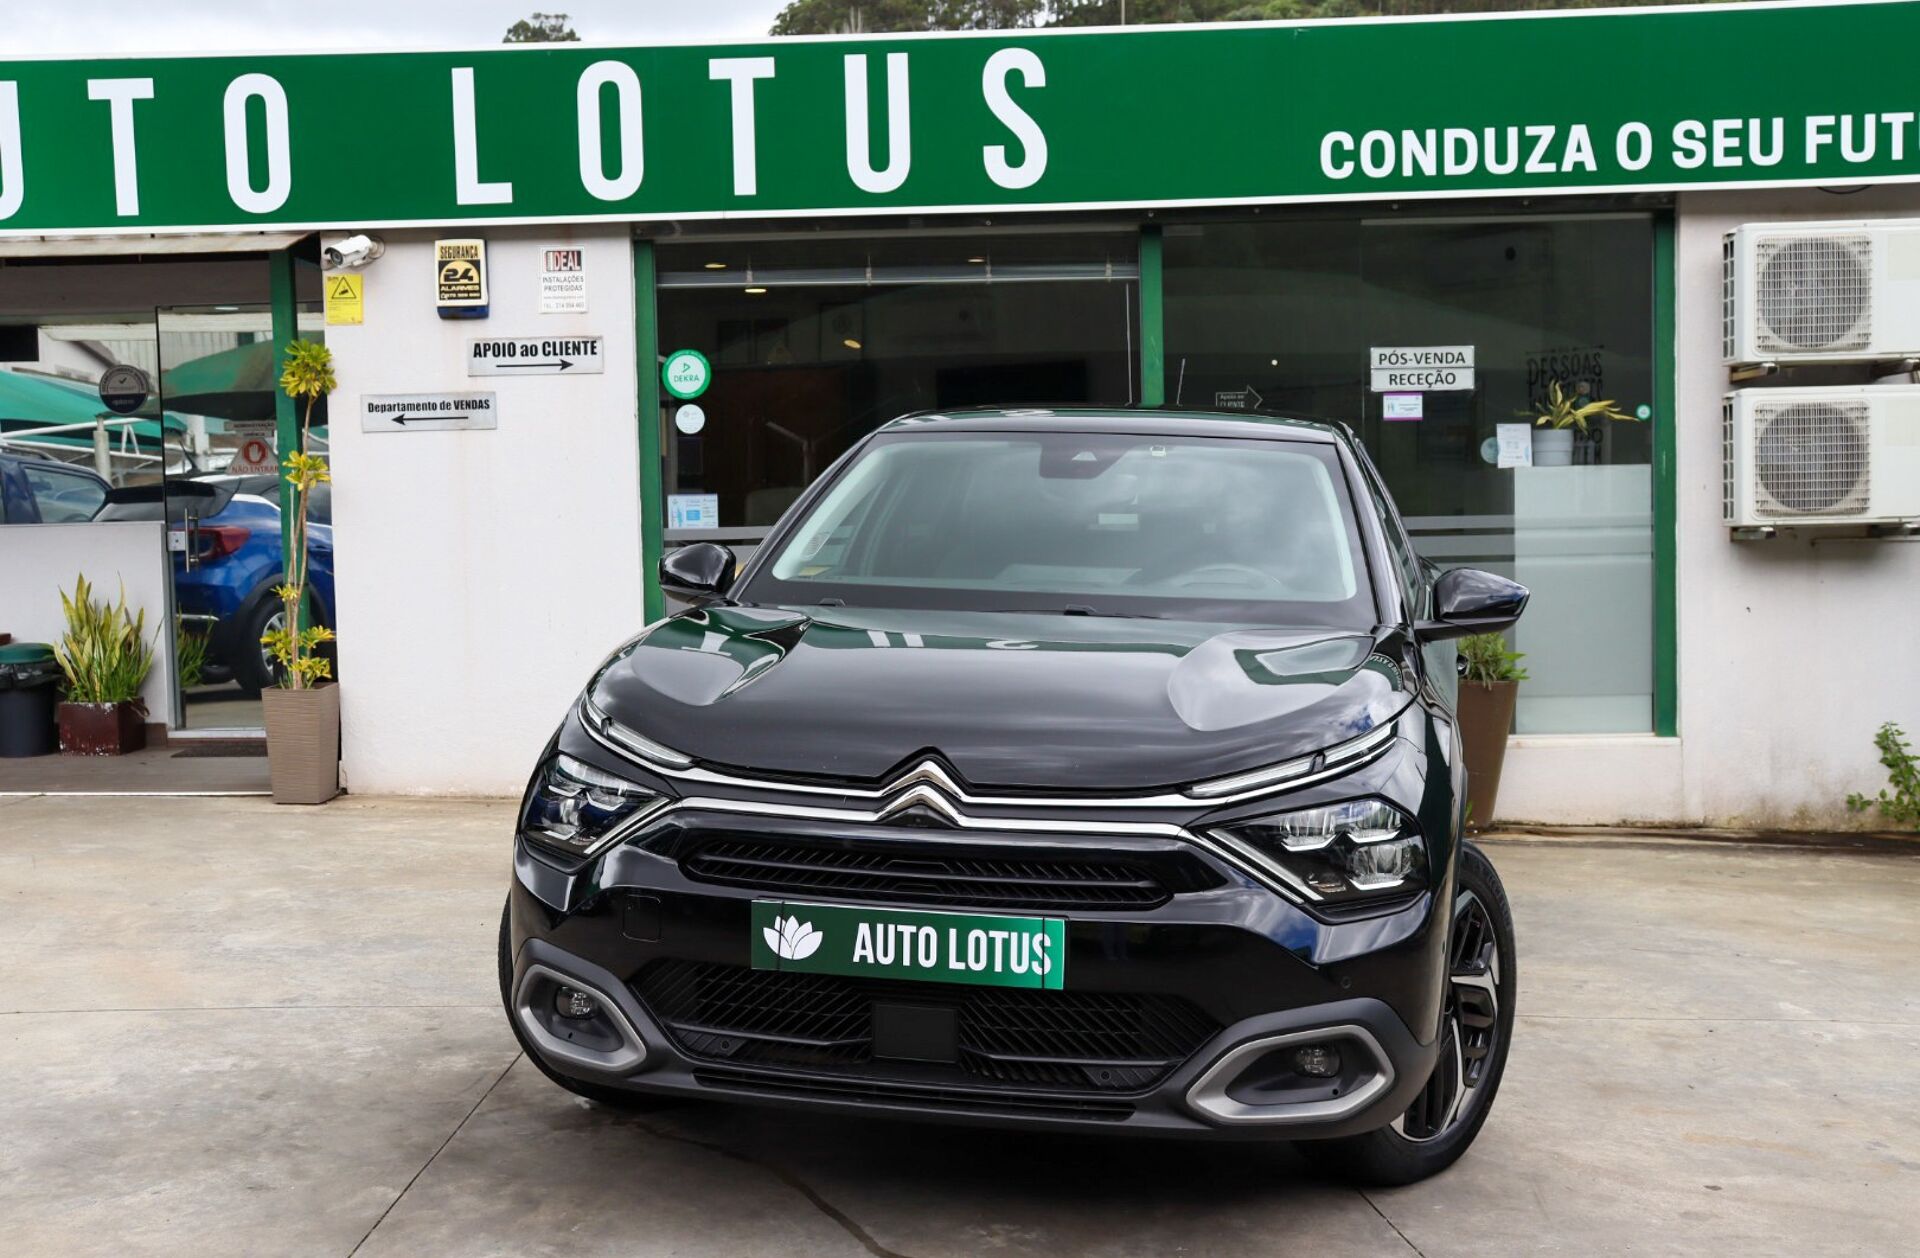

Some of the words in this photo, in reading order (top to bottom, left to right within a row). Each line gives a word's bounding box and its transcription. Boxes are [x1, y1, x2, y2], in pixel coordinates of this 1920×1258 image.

[451, 47, 1049, 205] LOTUS
[1320, 124, 1598, 179] CONDUZA
[1615, 122, 1652, 170] O
[1672, 117, 1784, 168] SEU
[1805, 112, 1920, 164] FUT
[544, 250, 582, 271] IDEAL
[444, 268, 474, 282] 24
[543, 275, 584, 284] INSTALAÇÕES
[544, 284, 583, 292] PROTEGIDAS
[473, 342, 516, 358] APOIO
[520, 344, 538, 357] ao
[542, 340, 598, 356] CLIENTE
[1379, 350, 1466, 365] PÓS-VENDA
[674, 374, 700, 382] DEKRA
[1527, 352, 1603, 388] PESSOAS
[1389, 369, 1456, 388] RECEÇÃO
[368, 401, 437, 413] Departamento
[439, 400, 451, 411] de
[454, 399, 490, 411] VENDAS
[232, 463, 249, 472] NÃO
[853, 922, 937, 968] AUTO
[949, 928, 1052, 975] LOTUS
